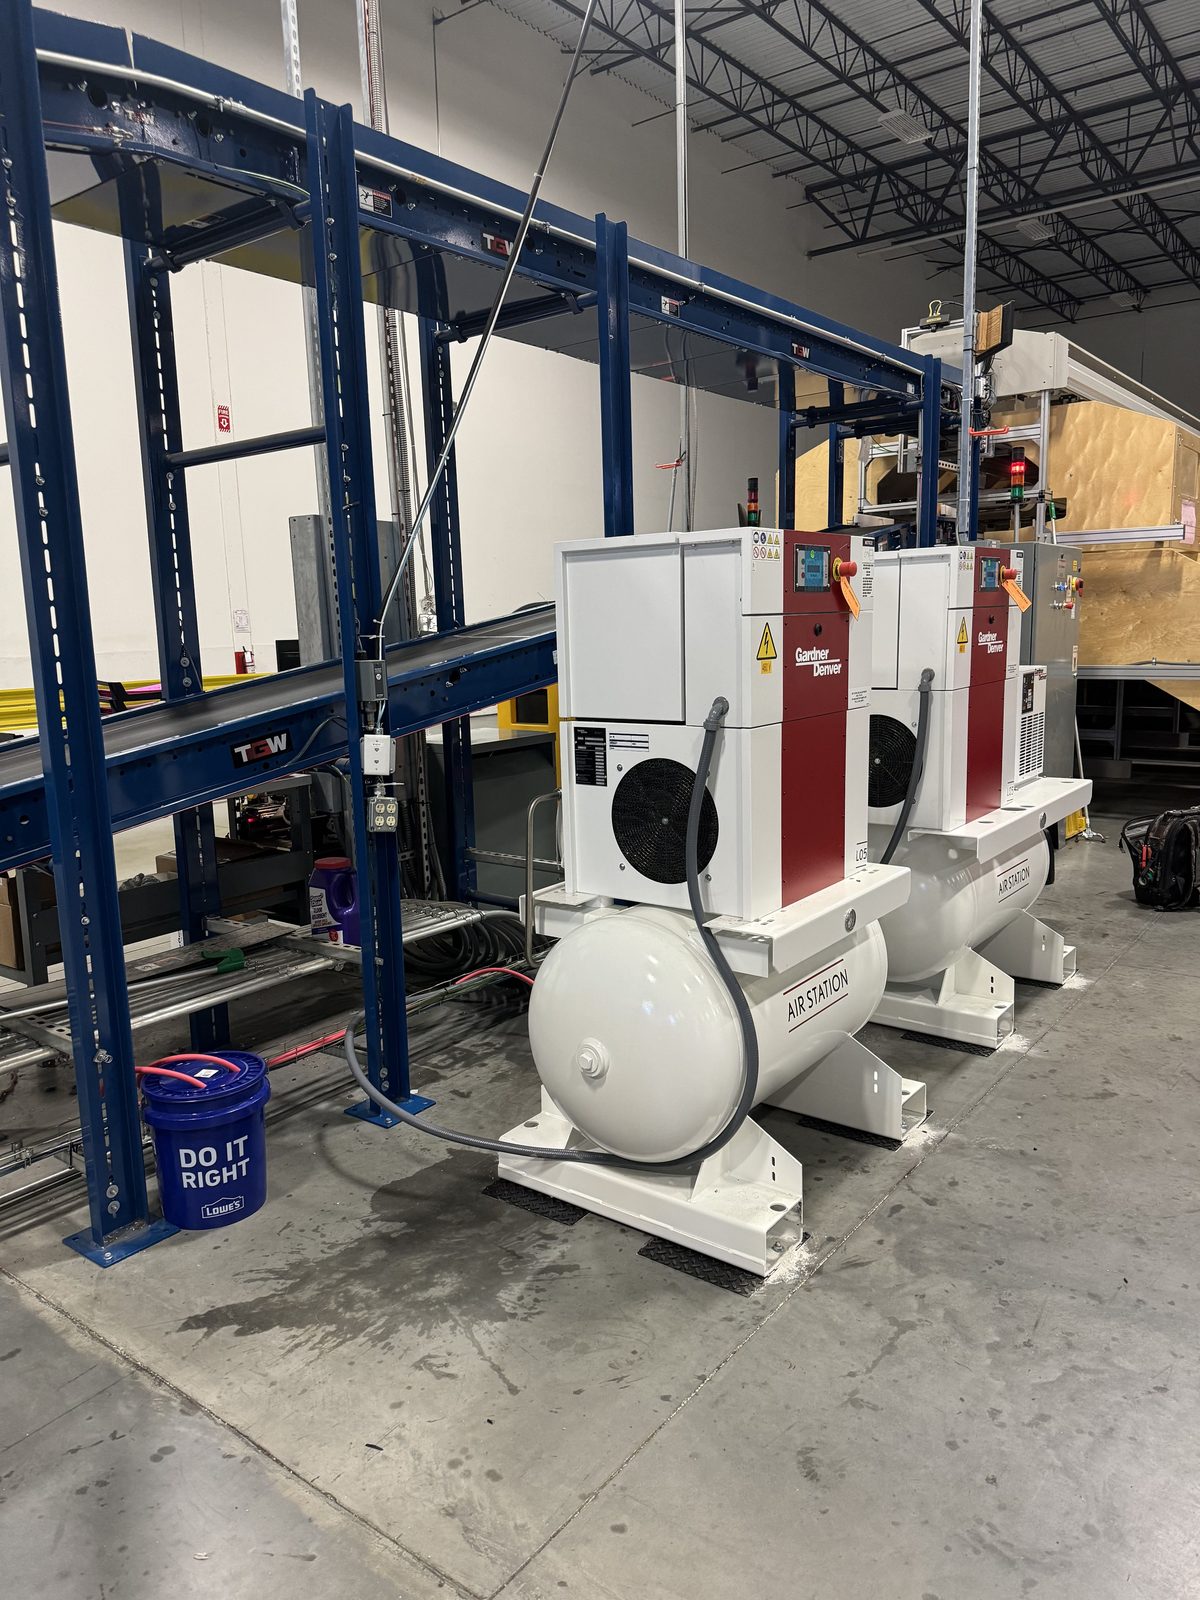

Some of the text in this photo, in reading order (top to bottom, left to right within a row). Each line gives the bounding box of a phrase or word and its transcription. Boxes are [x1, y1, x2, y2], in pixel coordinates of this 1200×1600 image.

[792, 343, 810, 358] TGW
[978, 631, 997, 642] Gardner
[795, 646, 829, 662] Gardner
[988, 643, 1003, 654] Denver
[813, 663, 842, 677] Denver
[234, 733, 287, 763] TGW
[998, 866, 1030, 895] AIR STATION
[788, 968, 848, 1022] AIR STATION
[179, 1135, 248, 1168] DO IT
[182, 1158, 250, 1189] RIGHT
